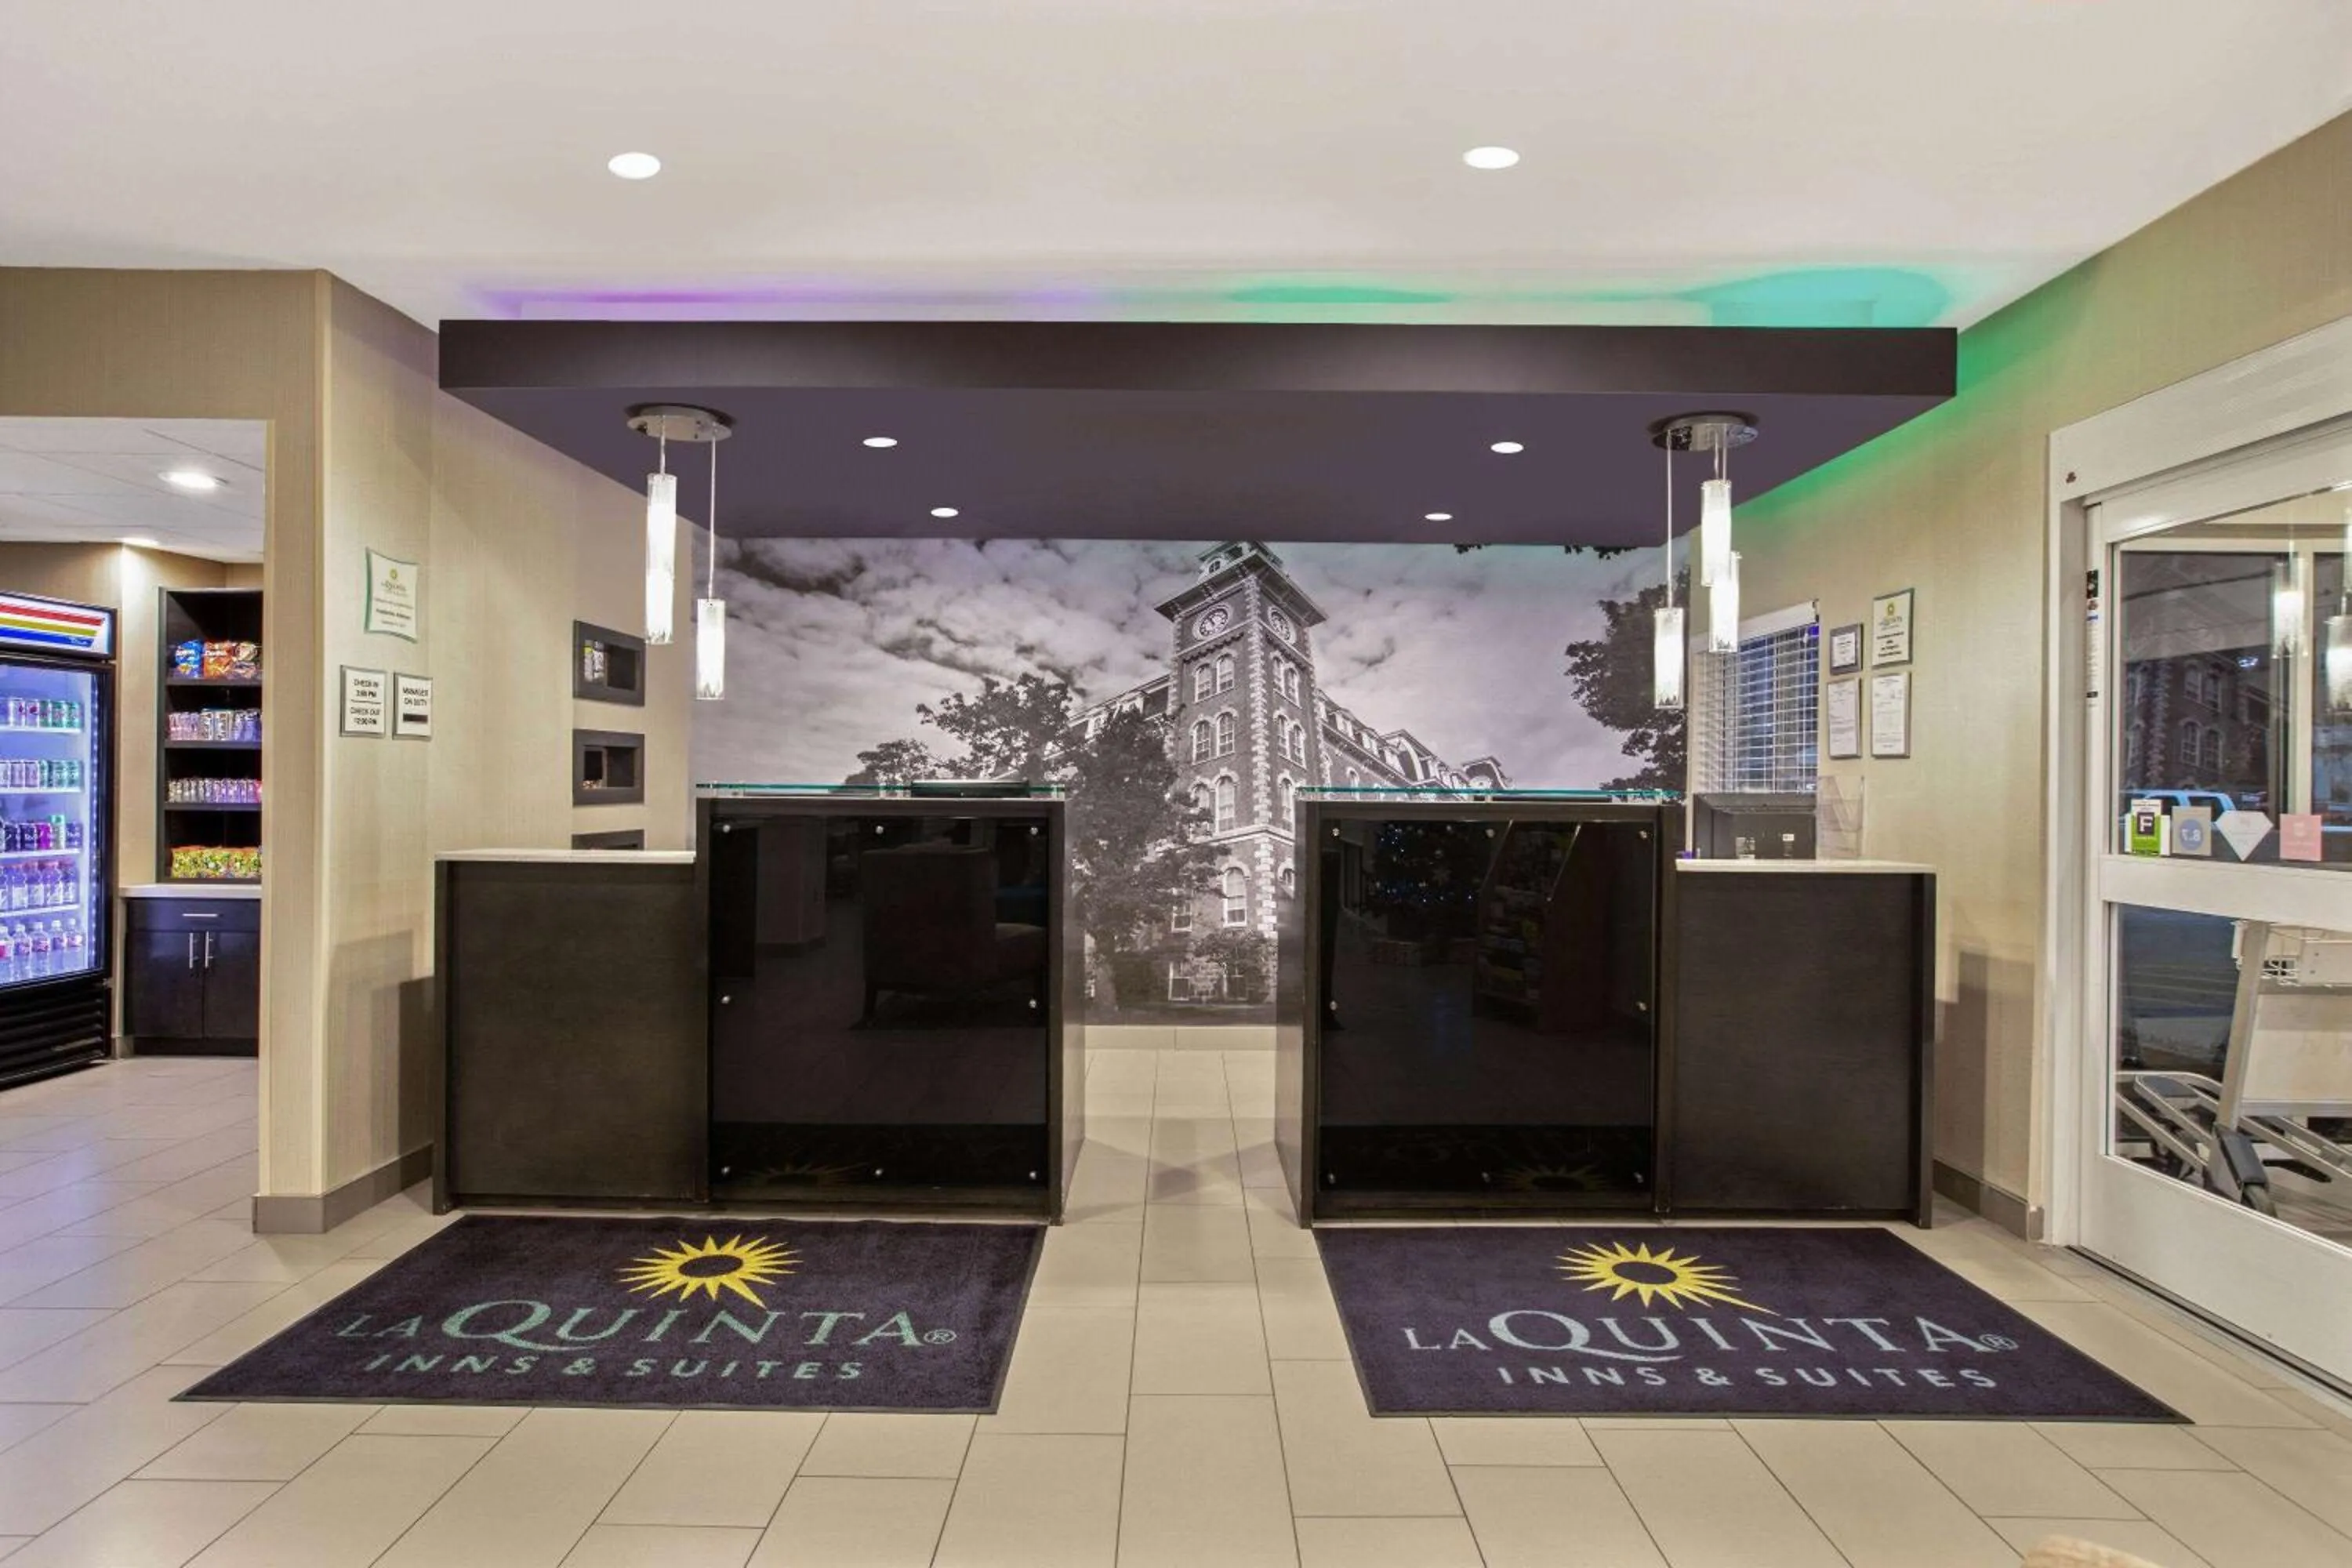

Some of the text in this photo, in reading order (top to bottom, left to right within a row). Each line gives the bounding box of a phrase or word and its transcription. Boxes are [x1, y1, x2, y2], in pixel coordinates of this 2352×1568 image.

[336, 1314, 423, 1338] LA
[1400, 1327, 1492, 1351] LA
[363, 1353, 862, 1380] INNS & SUITES
[1497, 1367, 1998, 1388] INNS & SUITES
